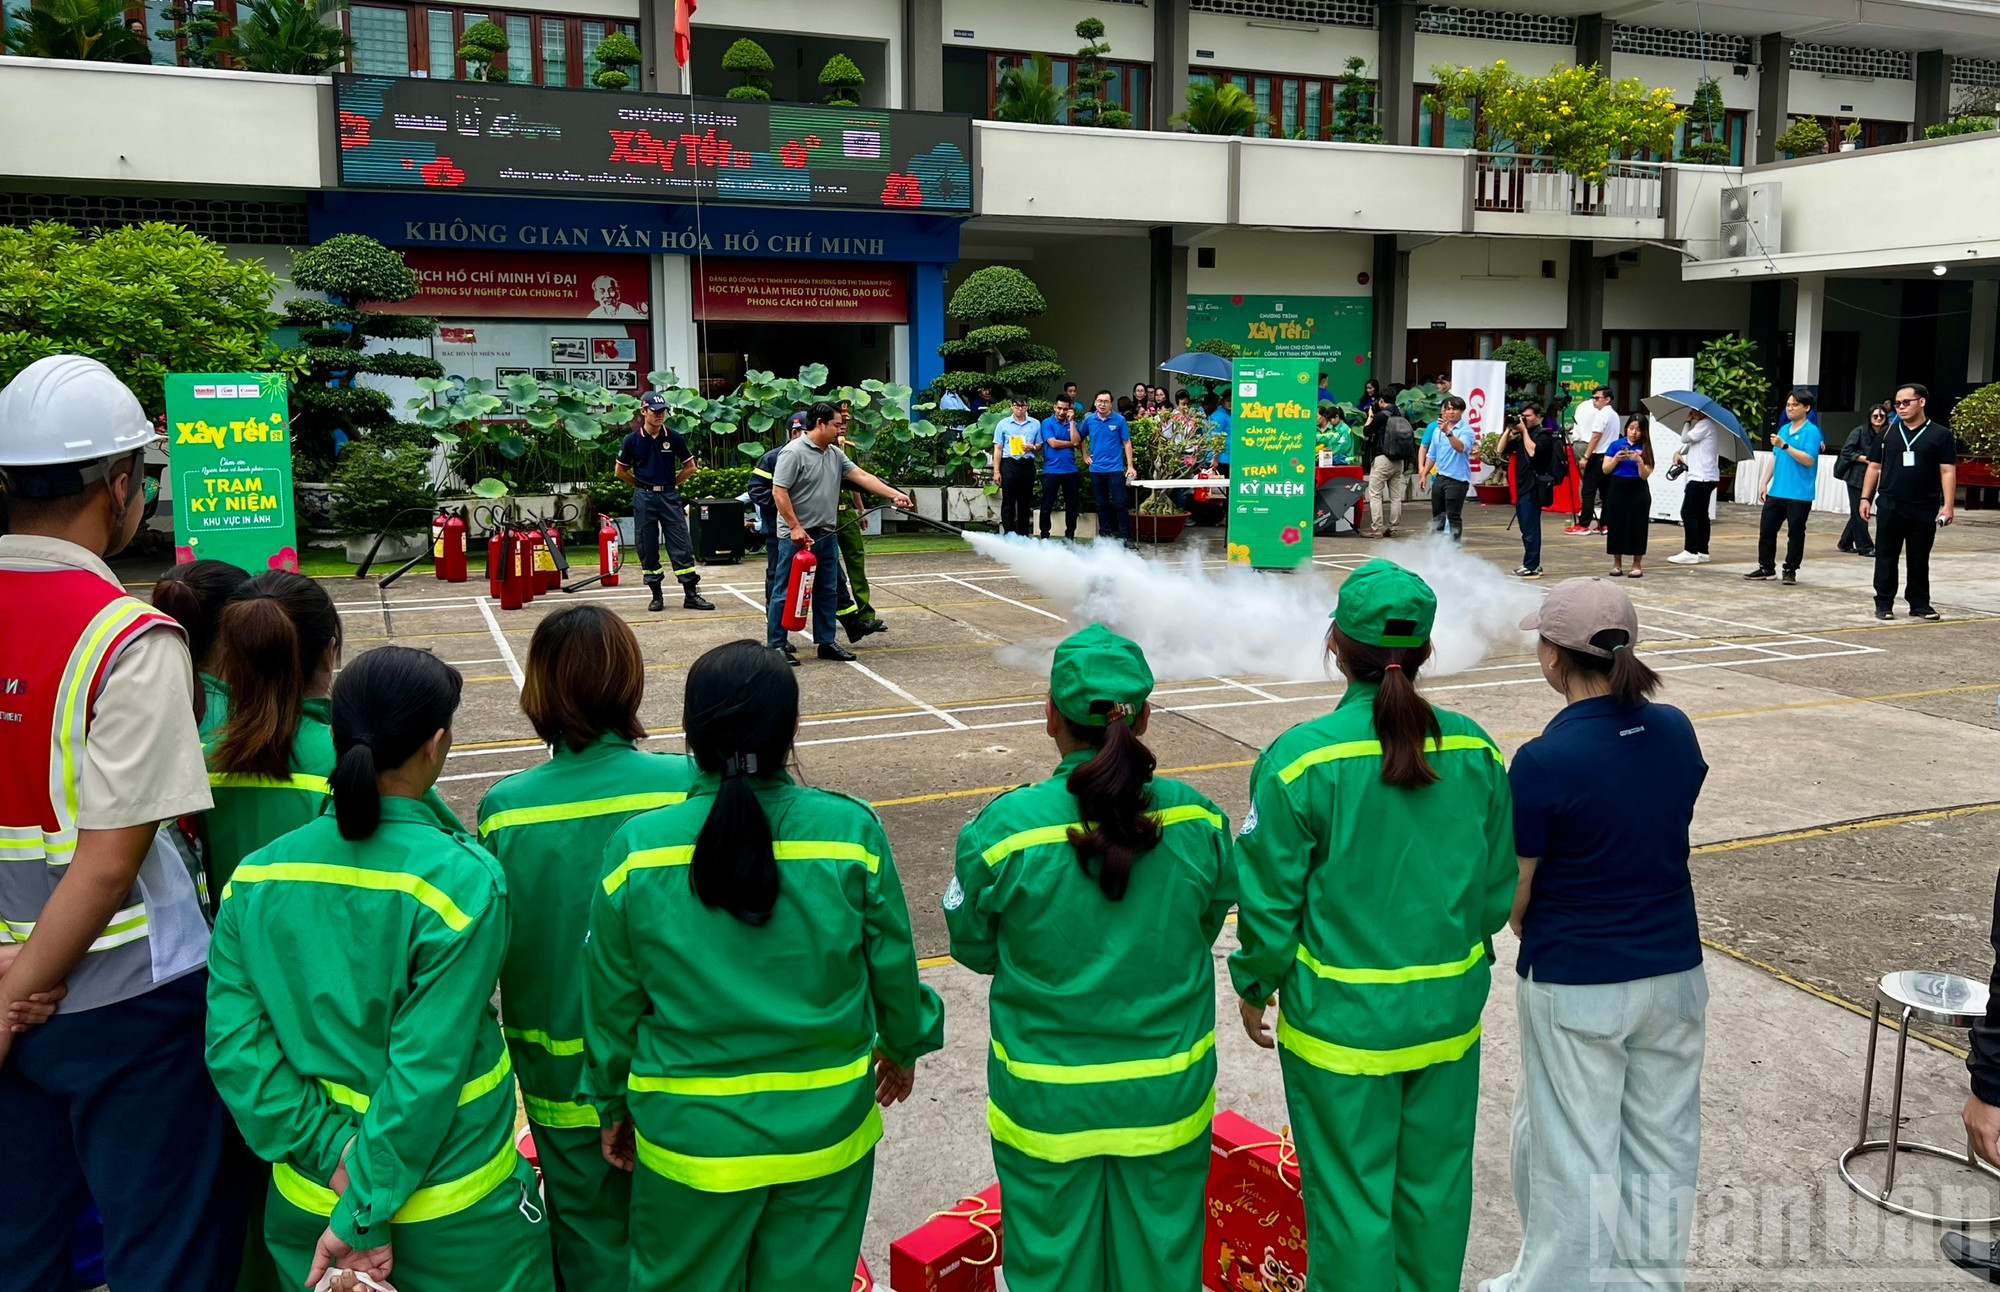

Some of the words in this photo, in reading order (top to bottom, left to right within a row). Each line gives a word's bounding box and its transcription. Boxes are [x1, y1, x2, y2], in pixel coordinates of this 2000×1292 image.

[608, 128, 678, 172] Xây
[405, 218, 507, 243] KHÔNG
[519, 225, 589, 246] GIAN
[601, 224, 651, 247] VĂN
[661, 226, 713, 250] HÓA
[724, 229, 759, 251] HỒ
[768, 232, 812, 253] CHÍ
[822, 237, 884, 255] MINH
[446, 268, 467, 282] HỒ
[471, 270, 493, 282] CHÍ
[498, 272, 534, 283] MINH
[537, 272, 550, 284] VĨ
[554, 273, 577, 287] ĐẠI
[425, 287, 457, 295] TRONG
[460, 287, 472, 297] SỰ
[474, 287, 507, 298] NGHIỆP
[509, 287, 527, 297] CỦA
[529, 288, 561, 297] CHÚNG
[562, 290, 573, 298] TA
[709, 285, 728, 295] HỌC
[729, 284, 746, 296] TẬP
[747, 285, 759, 294] VÀ
[760, 285, 780, 295] LÀM
[781, 287, 804, 295] THEO
[805, 287, 817, 296] TƯ
[818, 286, 851, 297] TƯỞNG,
[853, 288, 871, 298] ĐẠO
[747, 298, 778, 306] PHONG
[780, 298, 803, 306] CÁCH
[805, 297, 818, 307] HỒ
[820, 299, 834, 307] CHÍ
[1247, 321, 1278, 344] Xây
[1279, 319, 1302, 339] Tết
[1240, 401, 1274, 422] Xây
[1275, 400, 1302, 418] Tết
[175, 420, 228, 449] Xây
[230, 417, 269, 443] Tết
[1246, 425, 1263, 434] CẢM
[1242, 464, 1278, 477] TRẠM
[204, 477, 262, 494] TRẠM
[1240, 479, 1260, 494] KỶ
[1264, 480, 1304, 498] NIỆM
[191, 492, 218, 512] KỶ
[225, 492, 278, 512] NIỆM
[203, 517, 220, 526] KHU
[223, 516, 240, 526] VỰC
[242, 516, 251, 524] IN
[253, 514, 271, 523] ẢNH
